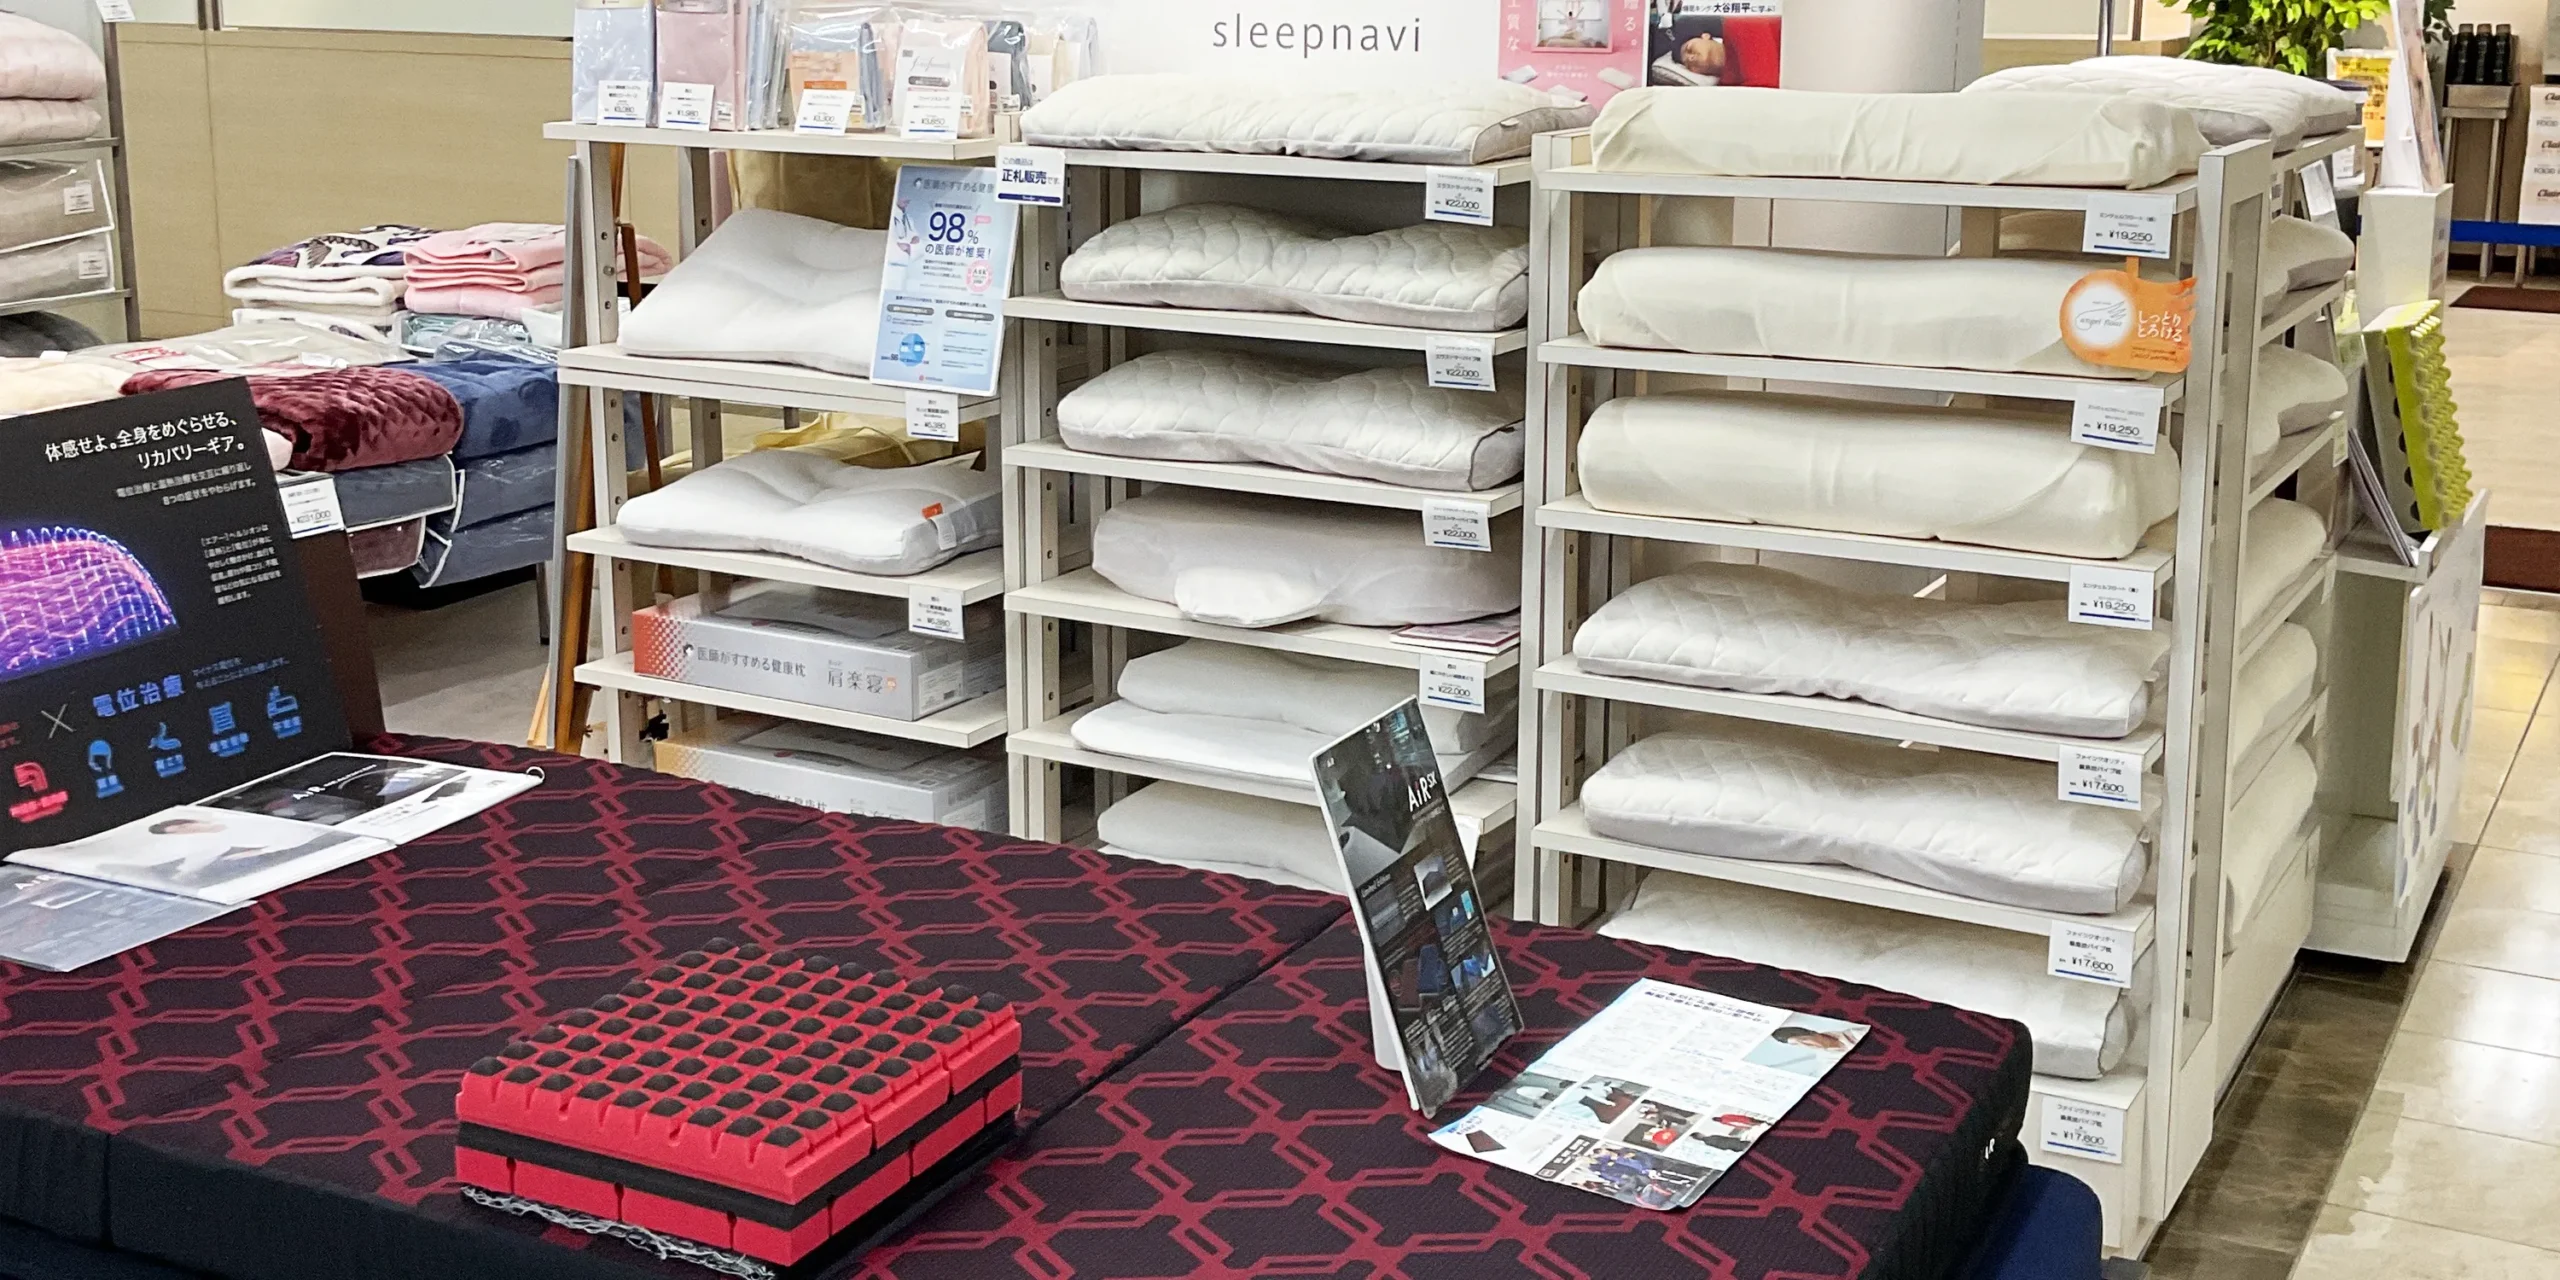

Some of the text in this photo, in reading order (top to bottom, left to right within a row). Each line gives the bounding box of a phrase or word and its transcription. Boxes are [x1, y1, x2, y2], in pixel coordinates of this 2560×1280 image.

[1213, 13, 1420, 58] sleepnavi
[1445, 198, 1479, 210] ¥22,000
[2109, 230, 2153, 242] ¥19,250
[2138, 310, 2182, 327] しっとり
[2137, 324, 2183, 343] とろける
[1445, 368, 1479, 378] ¥22,000
[2097, 422, 2140, 436] ¥19,250
[44, 411, 238, 463] 体感せよ。全身をめぐらせる、
[138, 436, 245, 470] リカバリーギア。
[1443, 529, 1477, 539] ¥22,000
[2093, 600, 2136, 612] ¥19,250
[697, 646, 806, 678] 医師がすすめる健康枕
[93, 674, 185, 717] 電位治療
[1438, 685, 1471, 697] ¥22,000
[2082, 780, 2124, 793] ¥17,600
[2072, 957, 2113, 971] ¥17,600
